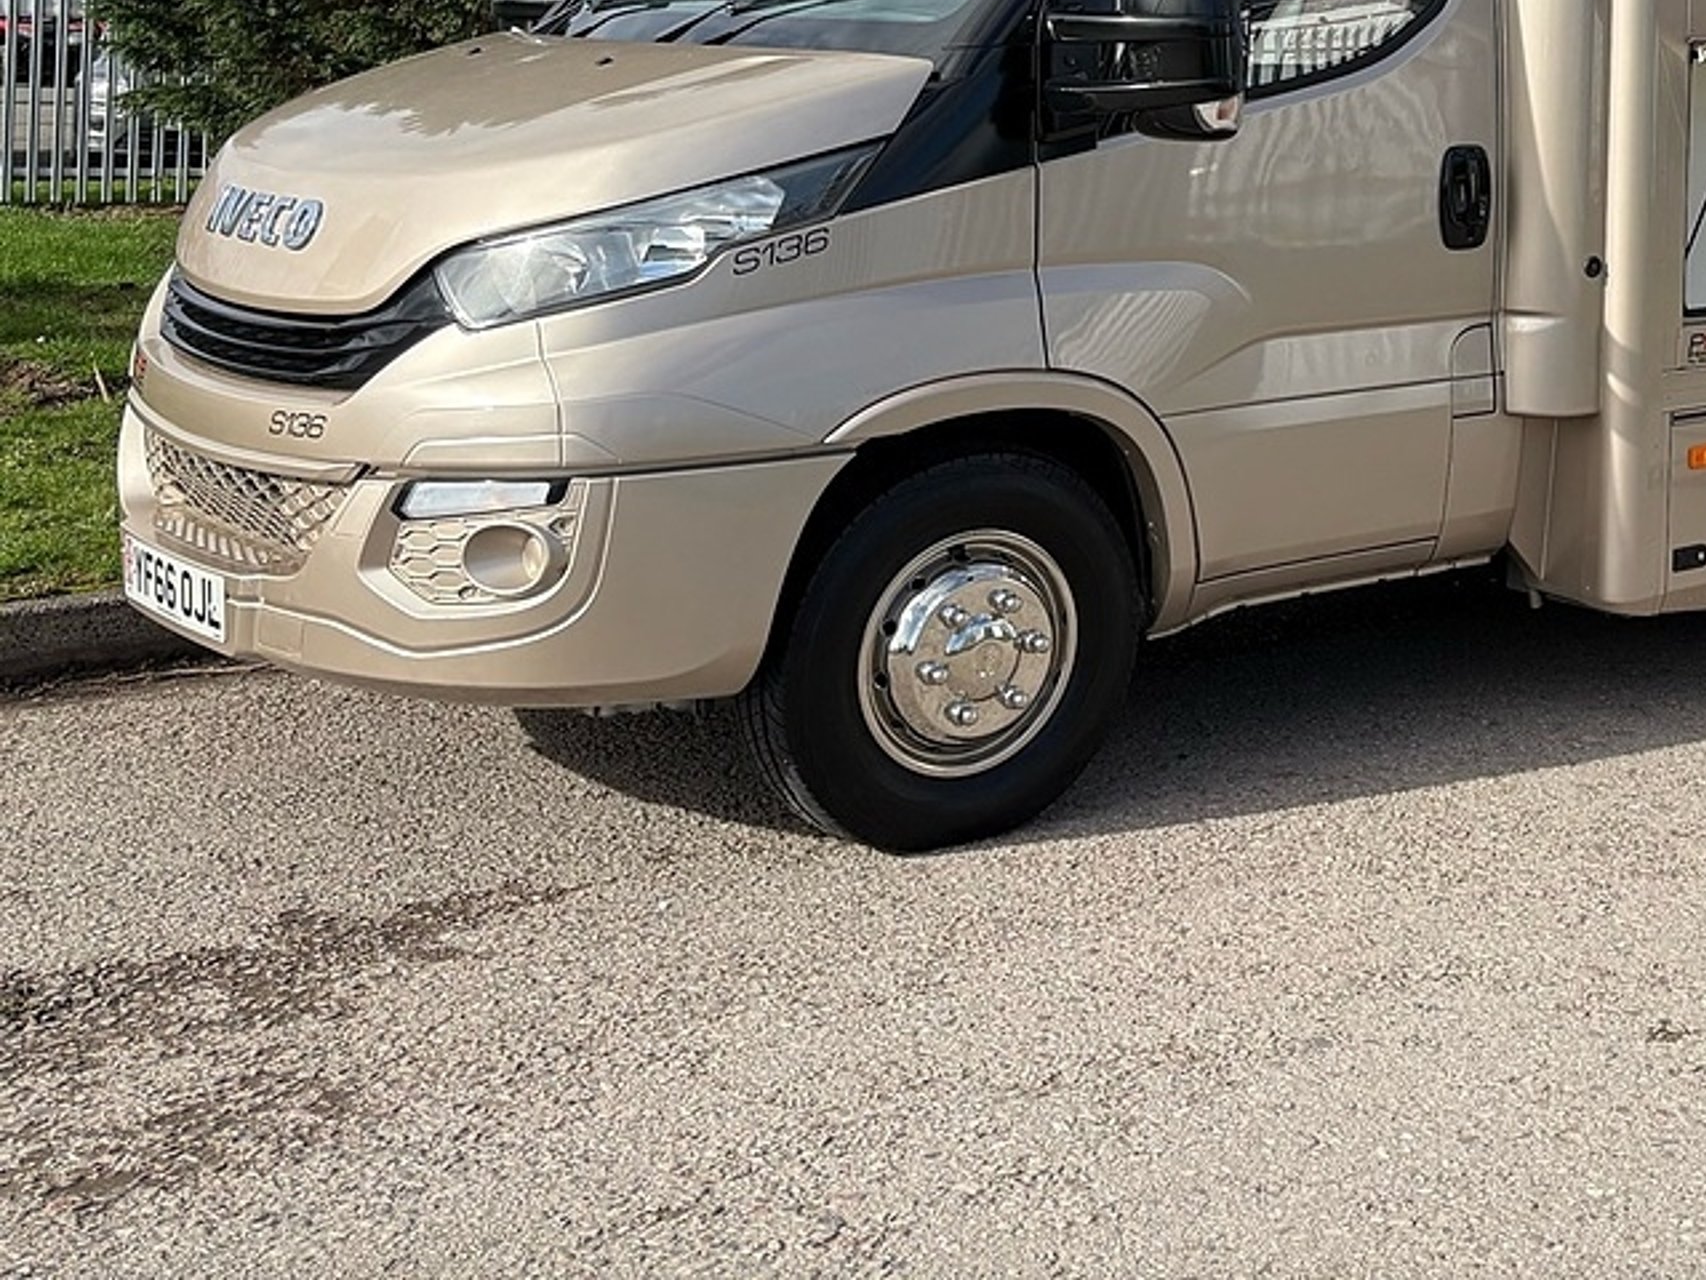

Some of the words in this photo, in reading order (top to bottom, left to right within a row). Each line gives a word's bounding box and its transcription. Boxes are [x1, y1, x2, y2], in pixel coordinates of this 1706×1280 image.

[207, 185, 323, 250] IVECO
[733, 228, 829, 275] S136
[269, 410, 328, 438] S136
[181, 569, 221, 630] OJL
